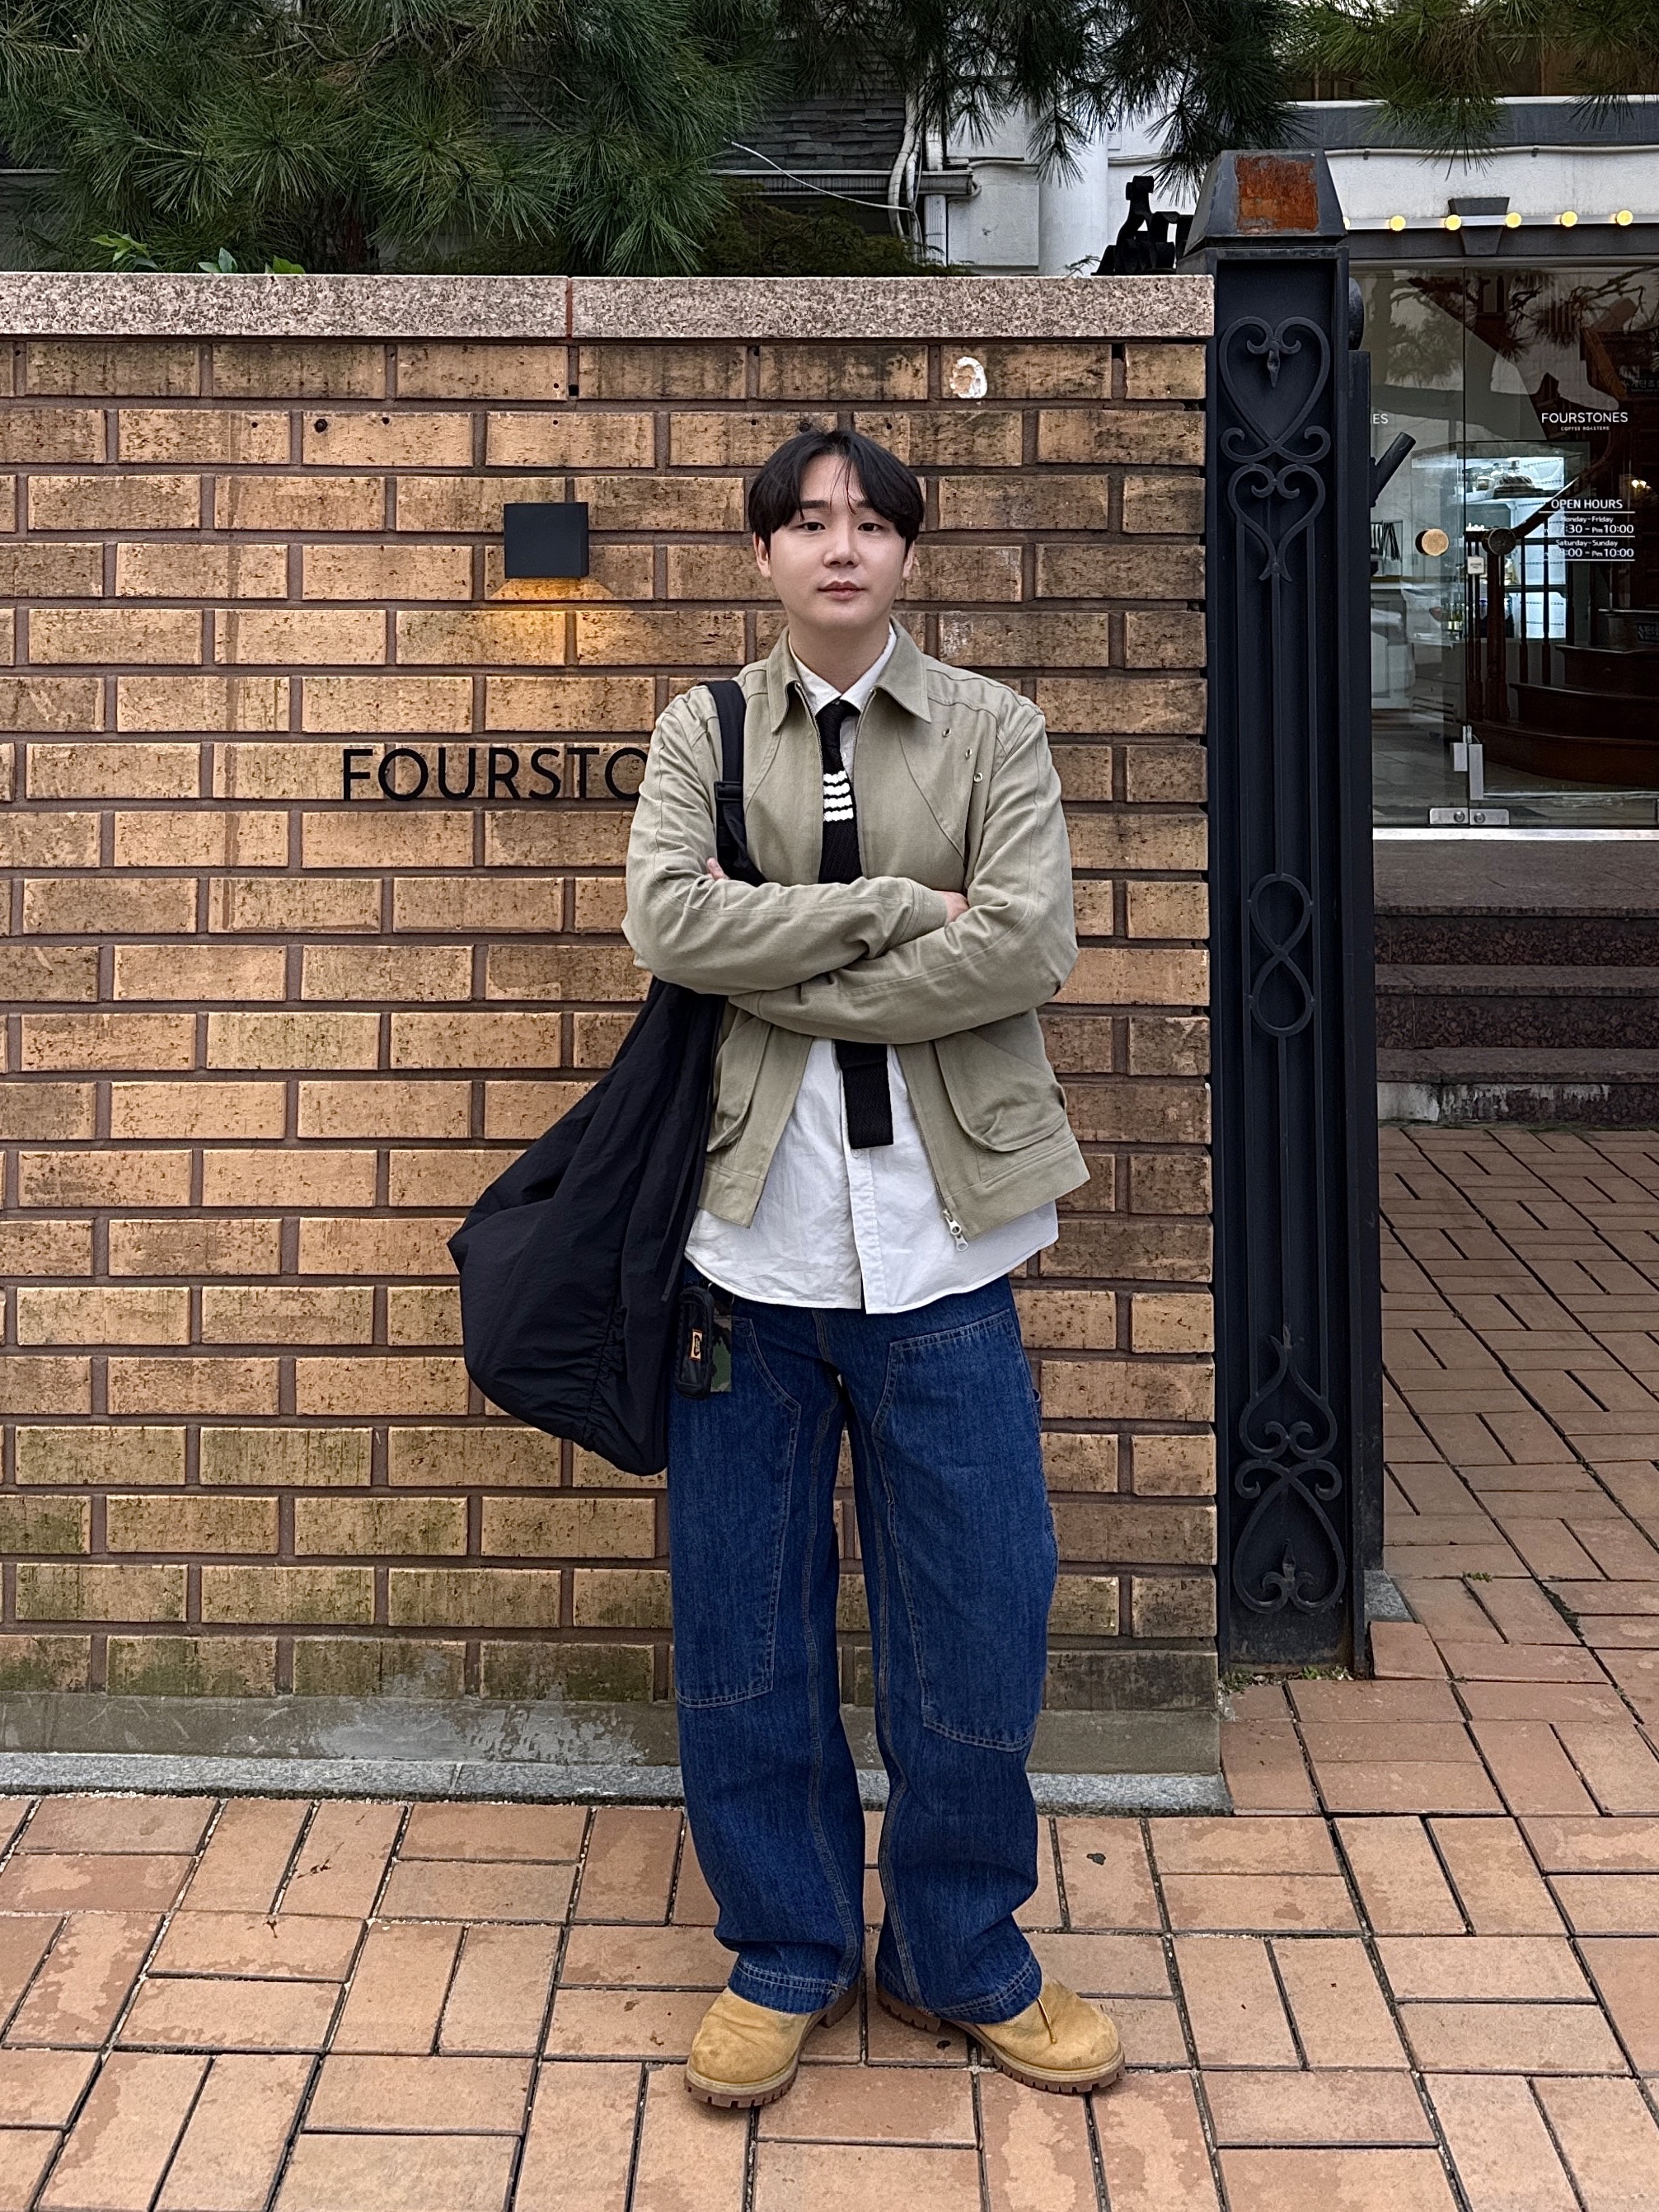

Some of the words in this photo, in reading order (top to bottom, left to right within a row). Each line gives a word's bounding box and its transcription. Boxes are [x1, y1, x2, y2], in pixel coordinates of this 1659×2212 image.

[1372, 413, 1389, 424] ES
[1541, 412, 1629, 423] FOURSTONES
[1551, 499, 1581, 508] OPEN
[1584, 499, 1623, 508] HOURS
[1604, 524, 1634, 533] 10:00
[1604, 548, 1634, 557] 10:00
[342, 747, 648, 802] FOURSTO
